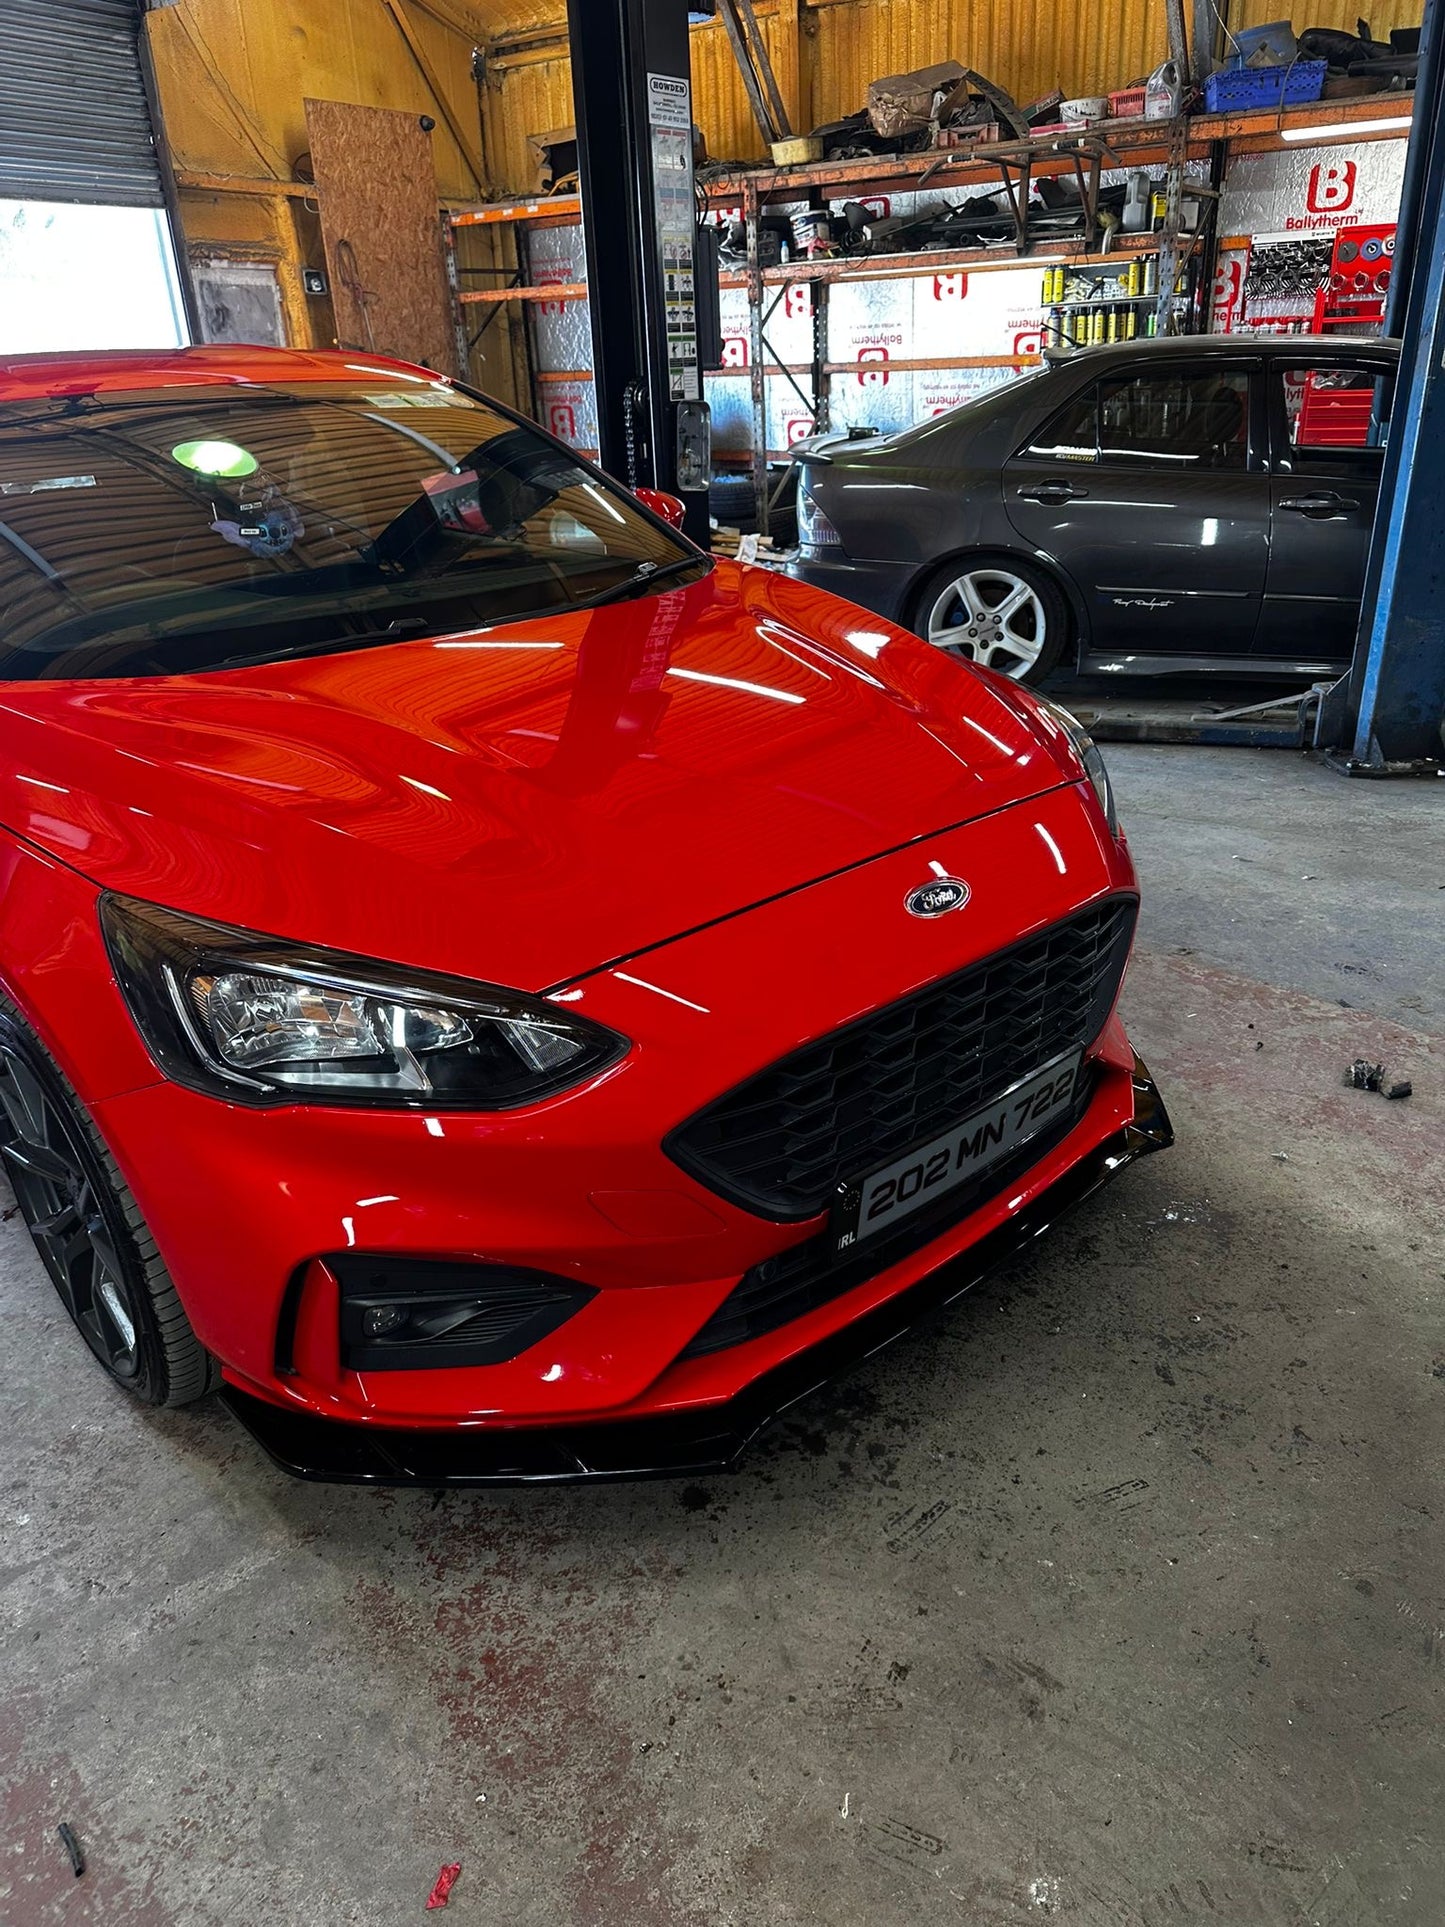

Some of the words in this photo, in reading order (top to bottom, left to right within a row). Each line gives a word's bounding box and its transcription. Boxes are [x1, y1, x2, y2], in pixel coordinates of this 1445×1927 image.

[652, 80, 685, 93] HOWDEN
[1286, 214, 1358, 230] Ballytherm
[851, 332, 902, 345] Ballytherm
[921, 887, 957, 910] Ford
[867, 1148, 950, 1221] 202
[956, 1112, 1007, 1170] MN
[1014, 1067, 1075, 1131] 722
